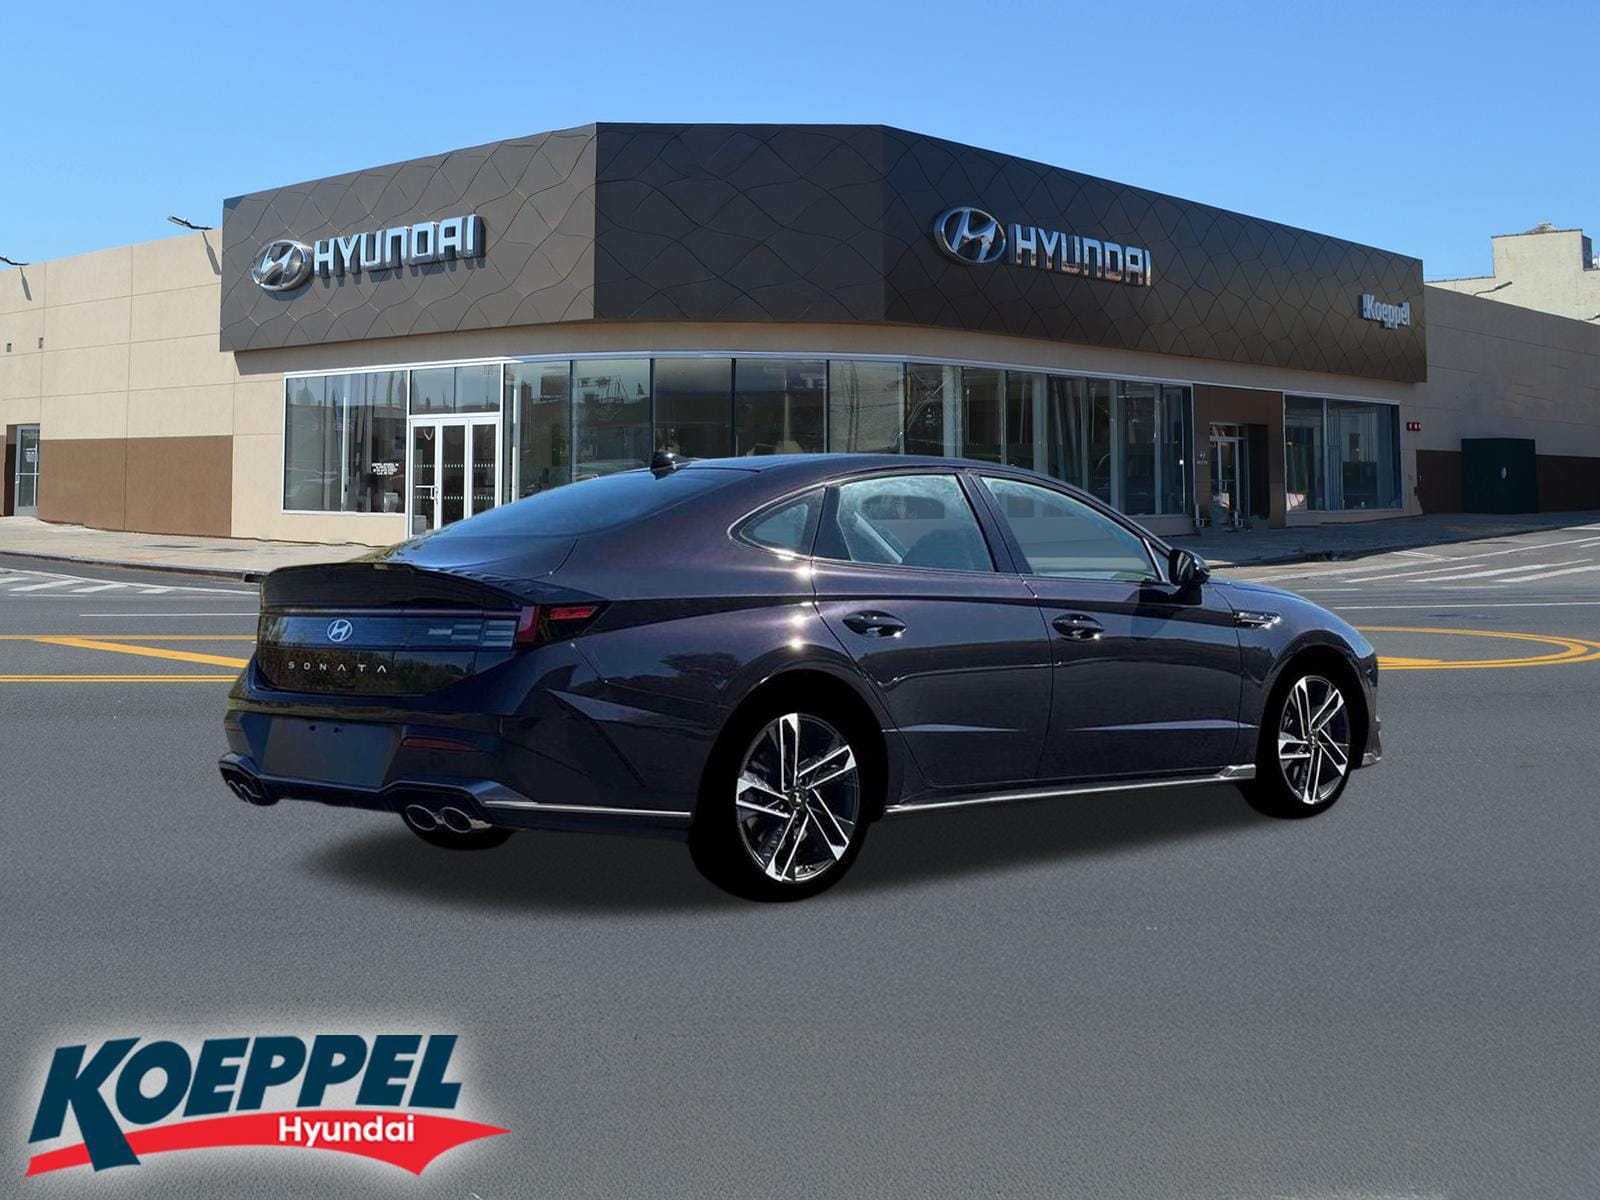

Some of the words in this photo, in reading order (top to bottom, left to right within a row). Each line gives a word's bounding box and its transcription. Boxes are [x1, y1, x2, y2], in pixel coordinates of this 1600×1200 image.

[313, 213, 484, 277] HYUNDAI
[1010, 223, 1151, 287] HYUNDAI
[1362, 293, 1410, 329] Koeppel
[288, 661, 387, 673] SONATA
